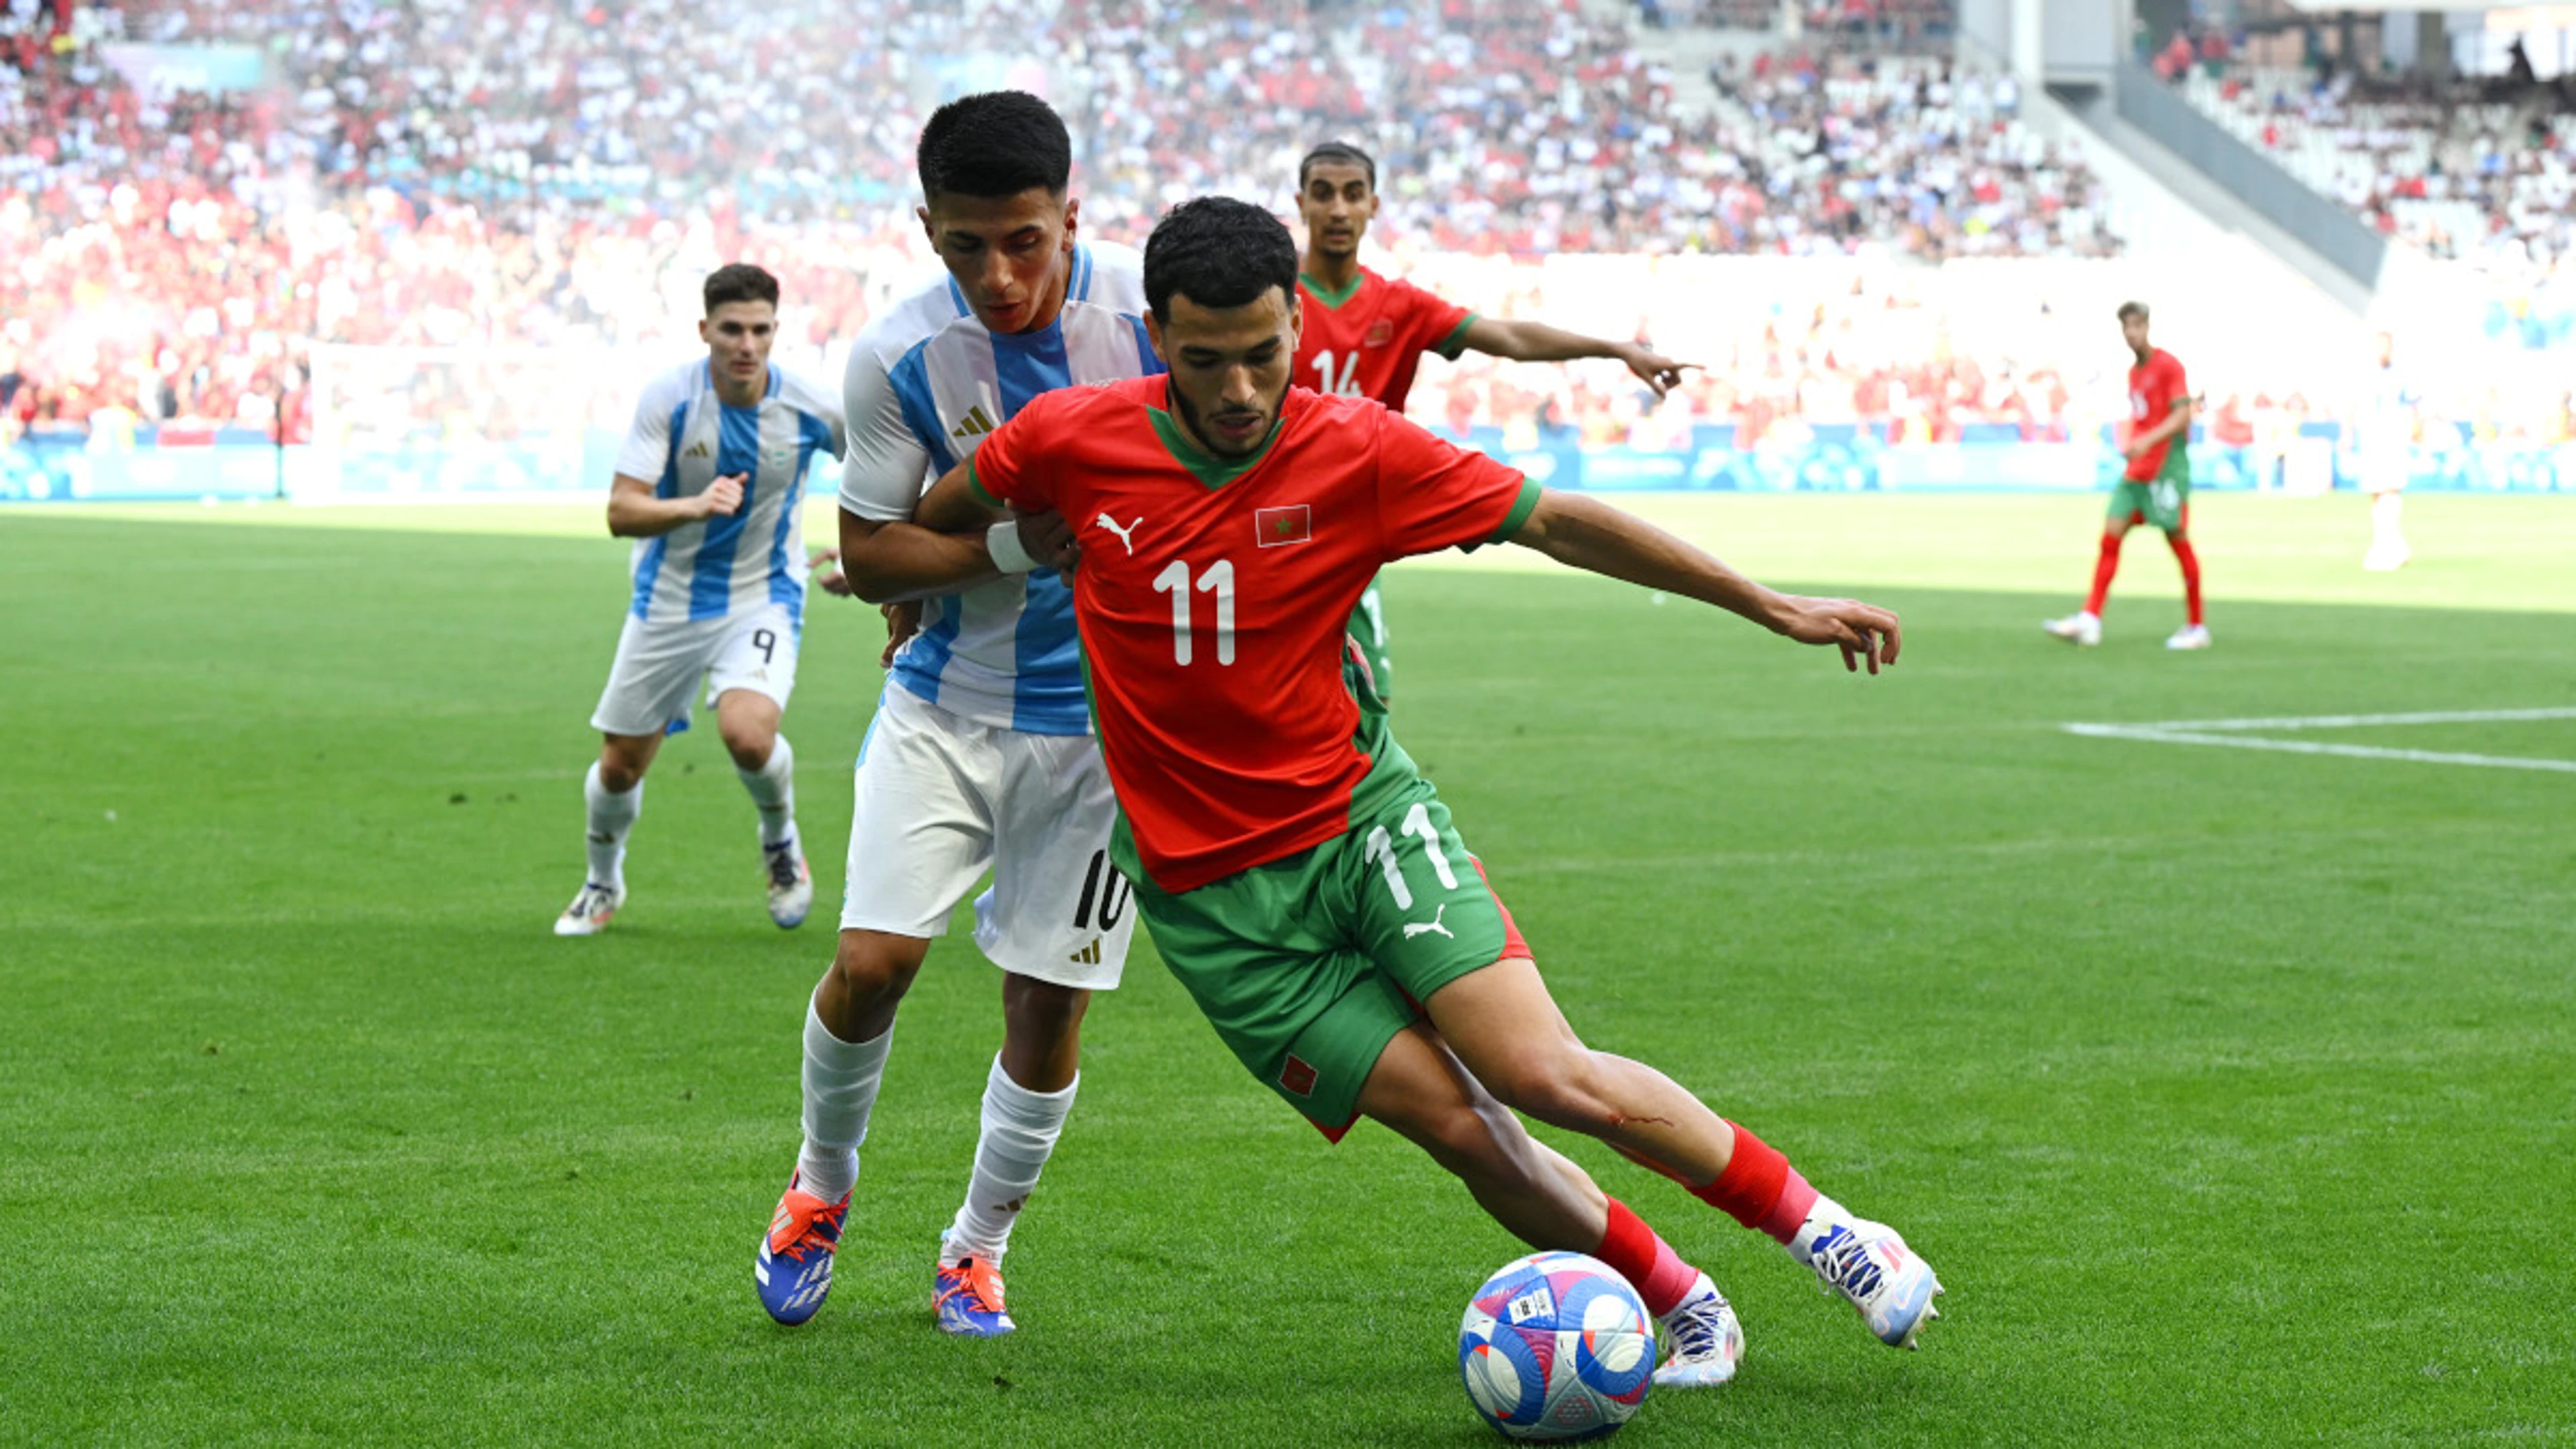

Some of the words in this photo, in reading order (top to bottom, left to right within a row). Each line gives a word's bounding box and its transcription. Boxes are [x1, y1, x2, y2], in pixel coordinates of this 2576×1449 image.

[1311, 349, 1362, 397] 14
[753, 628, 775, 664] 9
[1152, 559, 1235, 665] 11
[1075, 849, 1130, 932] 10
[1365, 803, 1458, 910] 11
